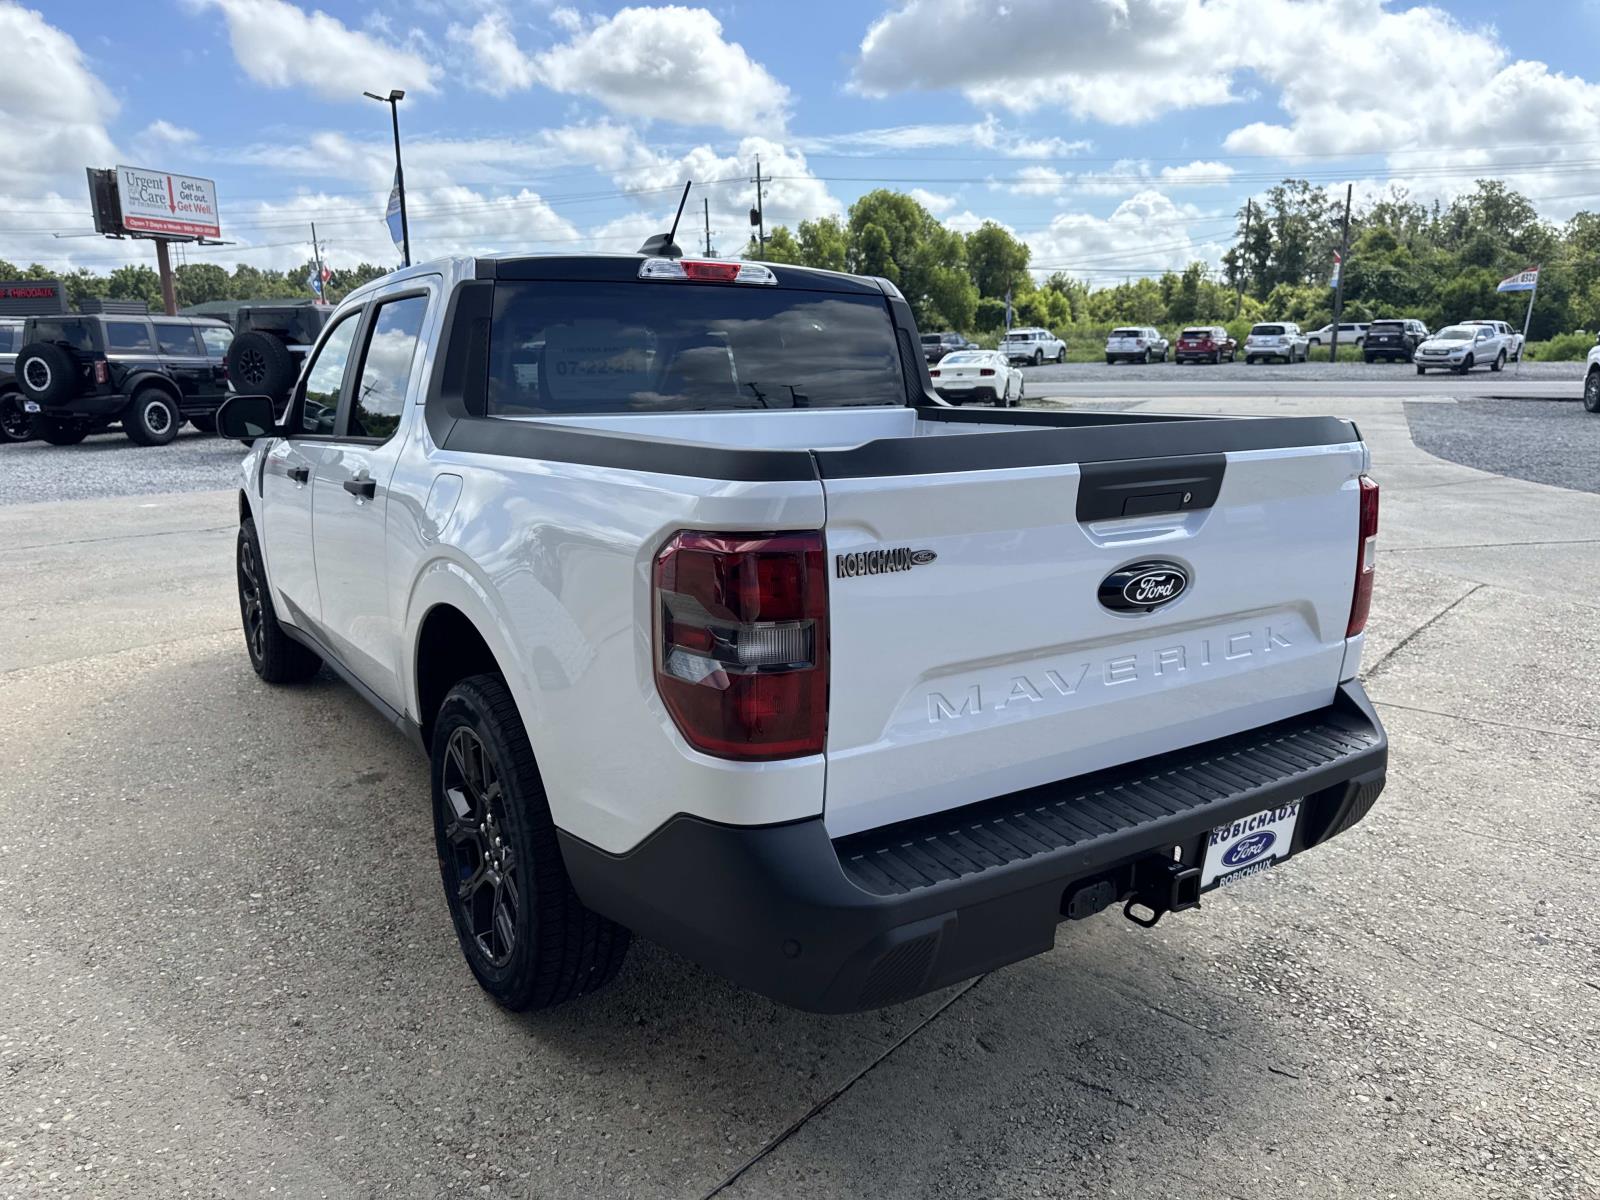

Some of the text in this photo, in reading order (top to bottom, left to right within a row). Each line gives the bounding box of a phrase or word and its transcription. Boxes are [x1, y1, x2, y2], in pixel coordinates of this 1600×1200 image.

[125, 172, 164, 191] Urgent
[181, 181, 204, 192] Get in.
[140, 189, 167, 204] Care
[177, 201, 194, 212] Get
[194, 203, 213, 215] Well.
[180, 192, 208, 203] Get out.
[836, 548, 912, 579] ROBICHAUX
[1136, 576, 1175, 600] Ford
[927, 623, 1294, 723] MAVERICK
[1209, 804, 1297, 846] ROBICHAUX
[1232, 836, 1267, 862] Ford
[1220, 859, 1272, 887] ROBICHAUX
